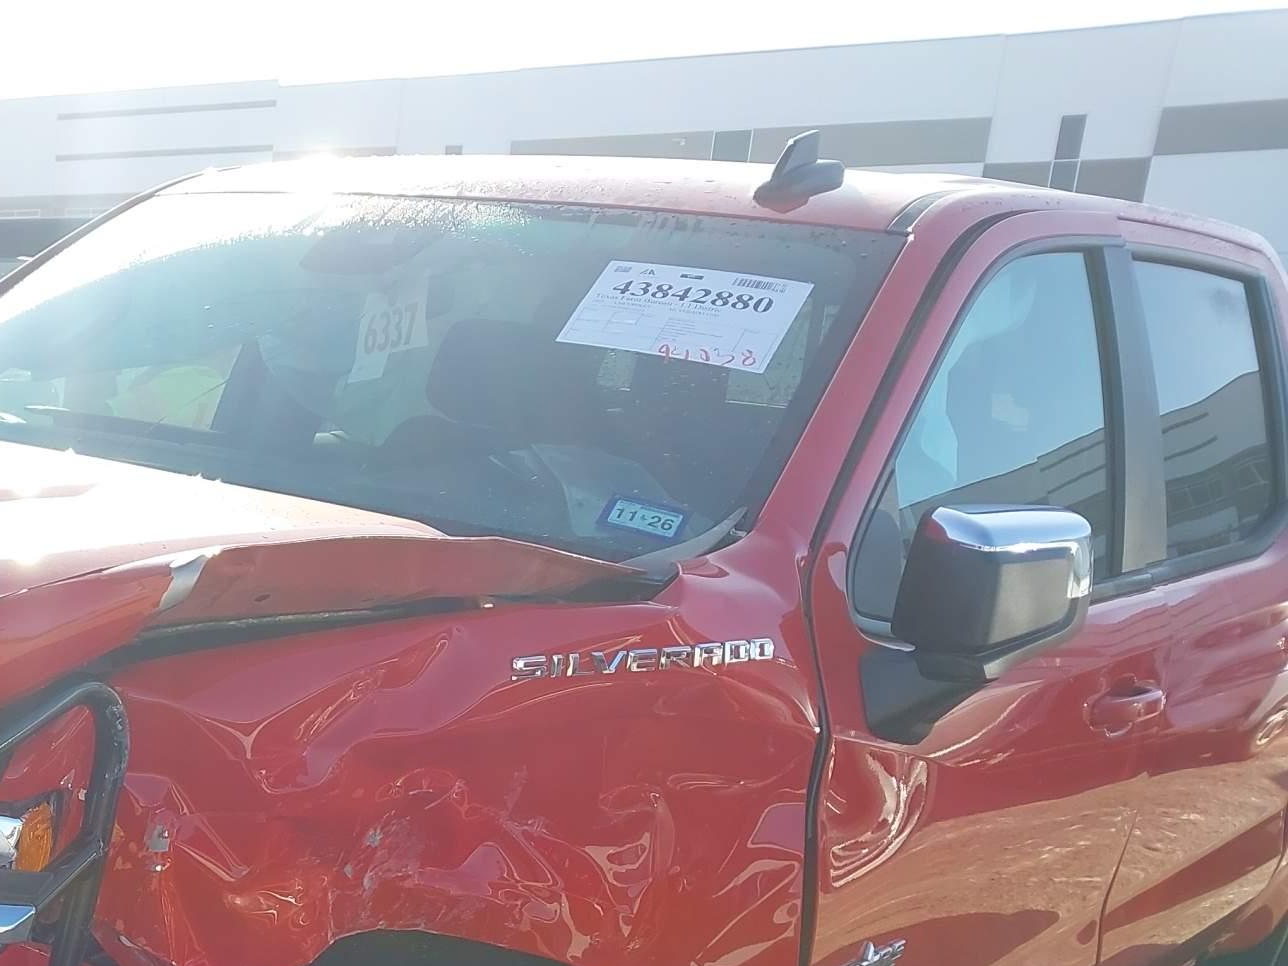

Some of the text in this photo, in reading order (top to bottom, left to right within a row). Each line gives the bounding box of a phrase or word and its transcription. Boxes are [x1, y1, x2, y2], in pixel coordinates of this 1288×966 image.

[612, 280, 774, 314] 43842880
[363, 298, 402, 355] 6337
[616, 507, 675, 532] 11 26
[510, 637, 775, 681] SILVERADO
